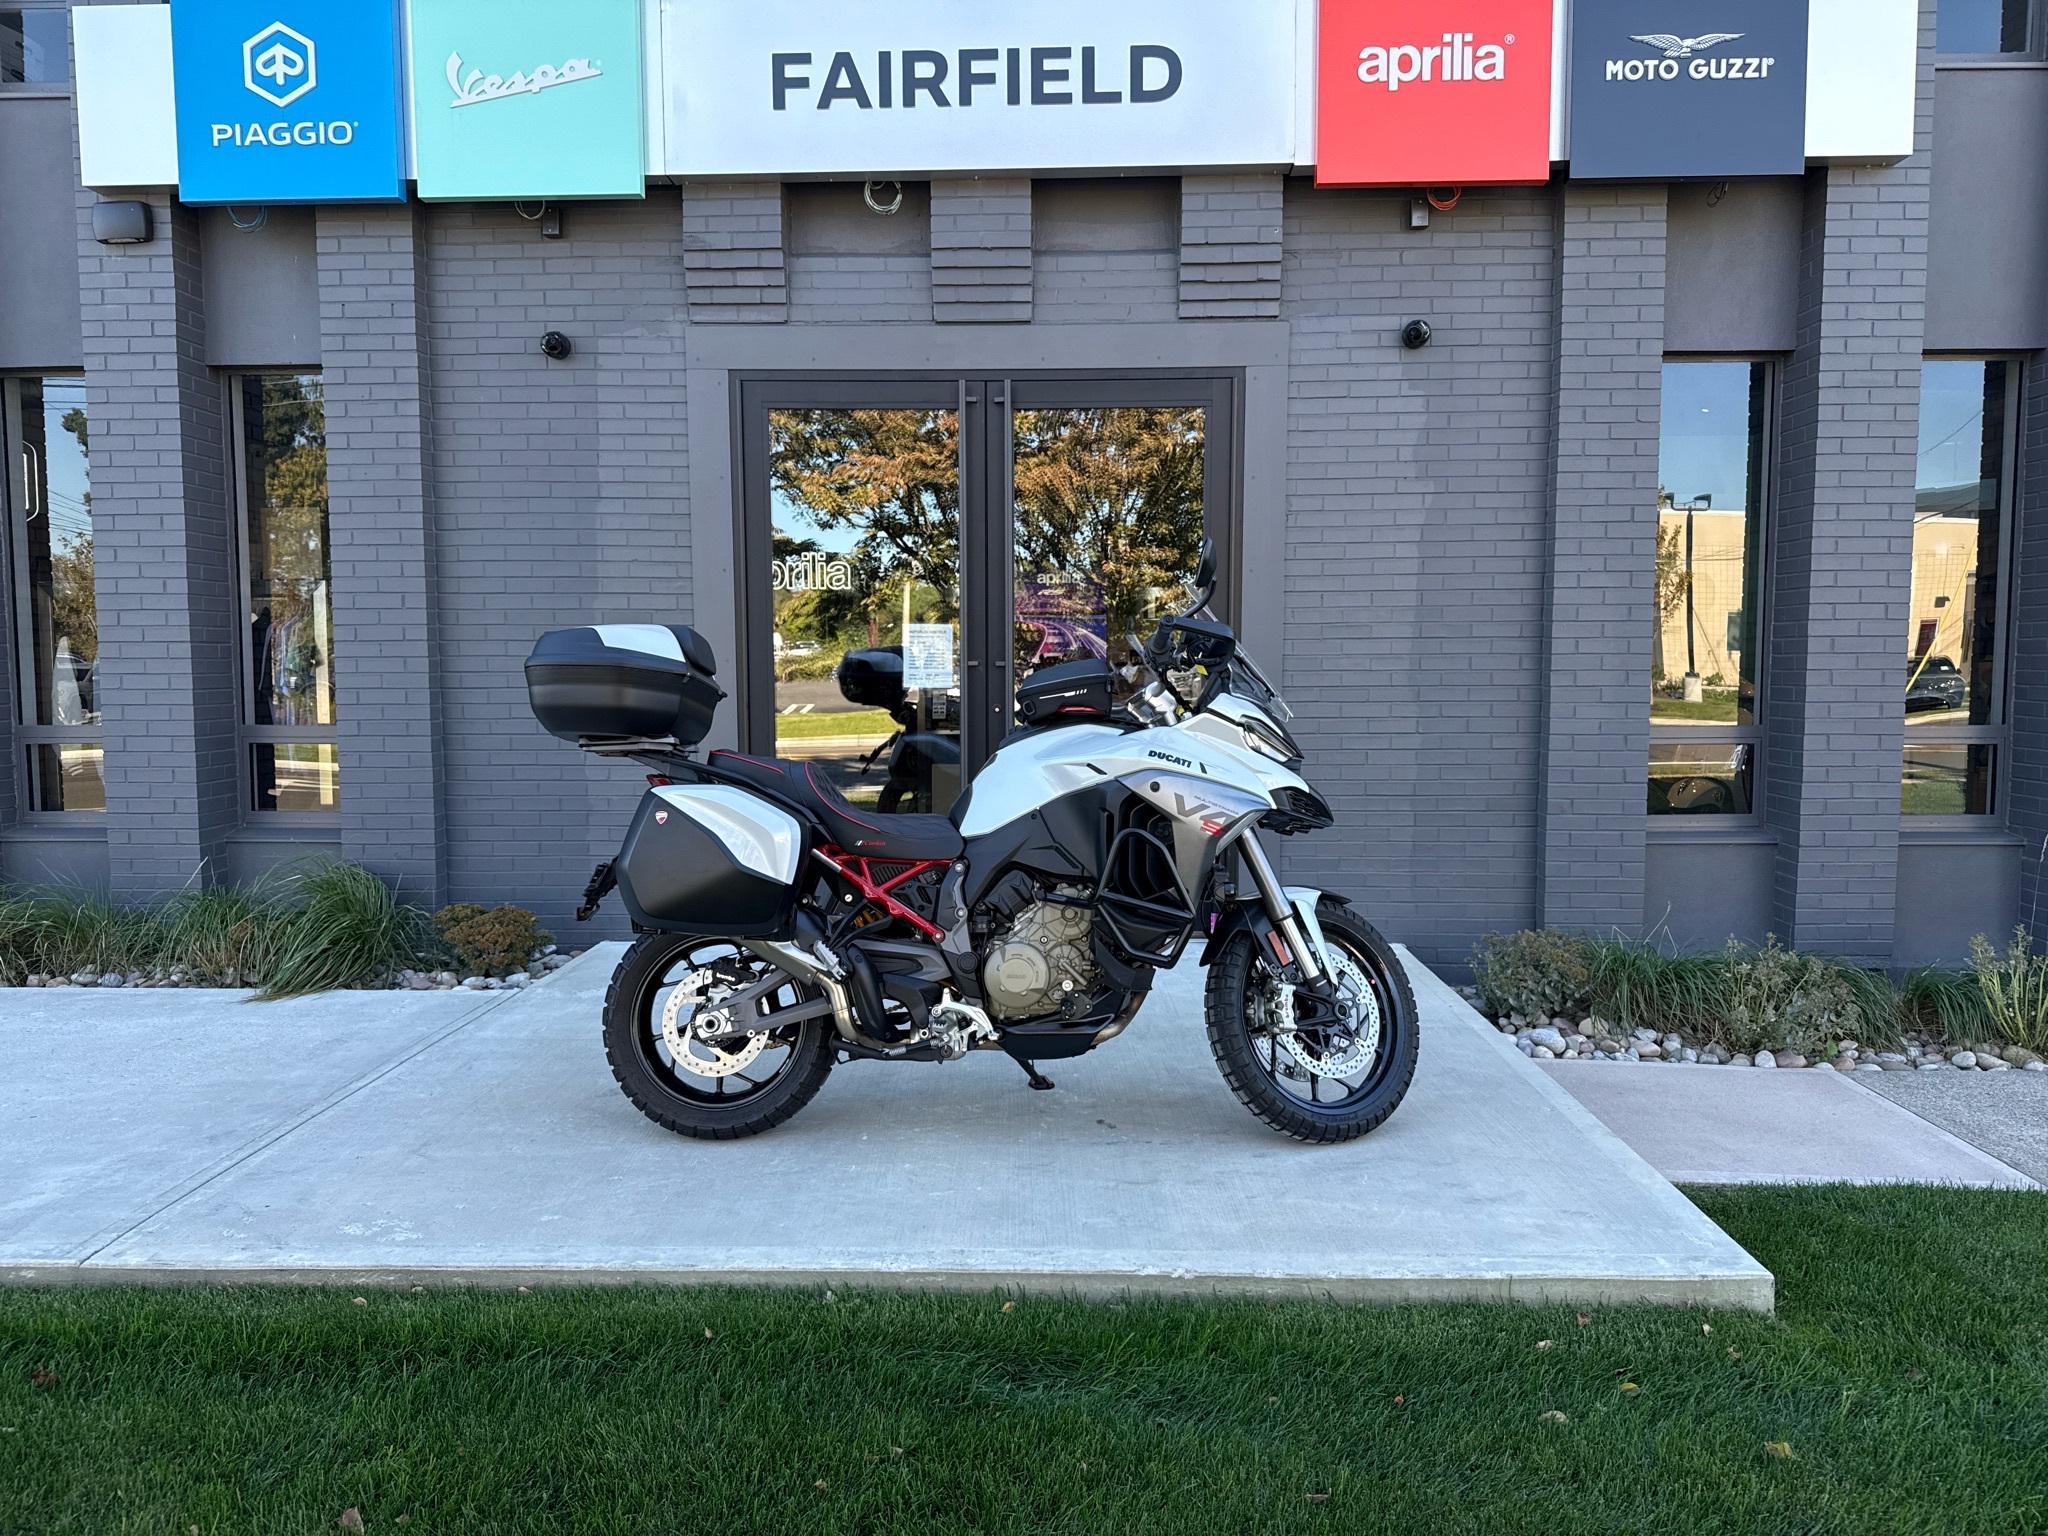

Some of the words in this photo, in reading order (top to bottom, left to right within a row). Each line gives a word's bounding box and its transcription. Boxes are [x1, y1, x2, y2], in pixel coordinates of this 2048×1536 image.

[446, 51, 603, 108] Vespa
[772, 45, 1183, 110] FAIRFIELD
[1605, 59, 1679, 81] MOTO
[1148, 750, 1192, 768] DUCATI
